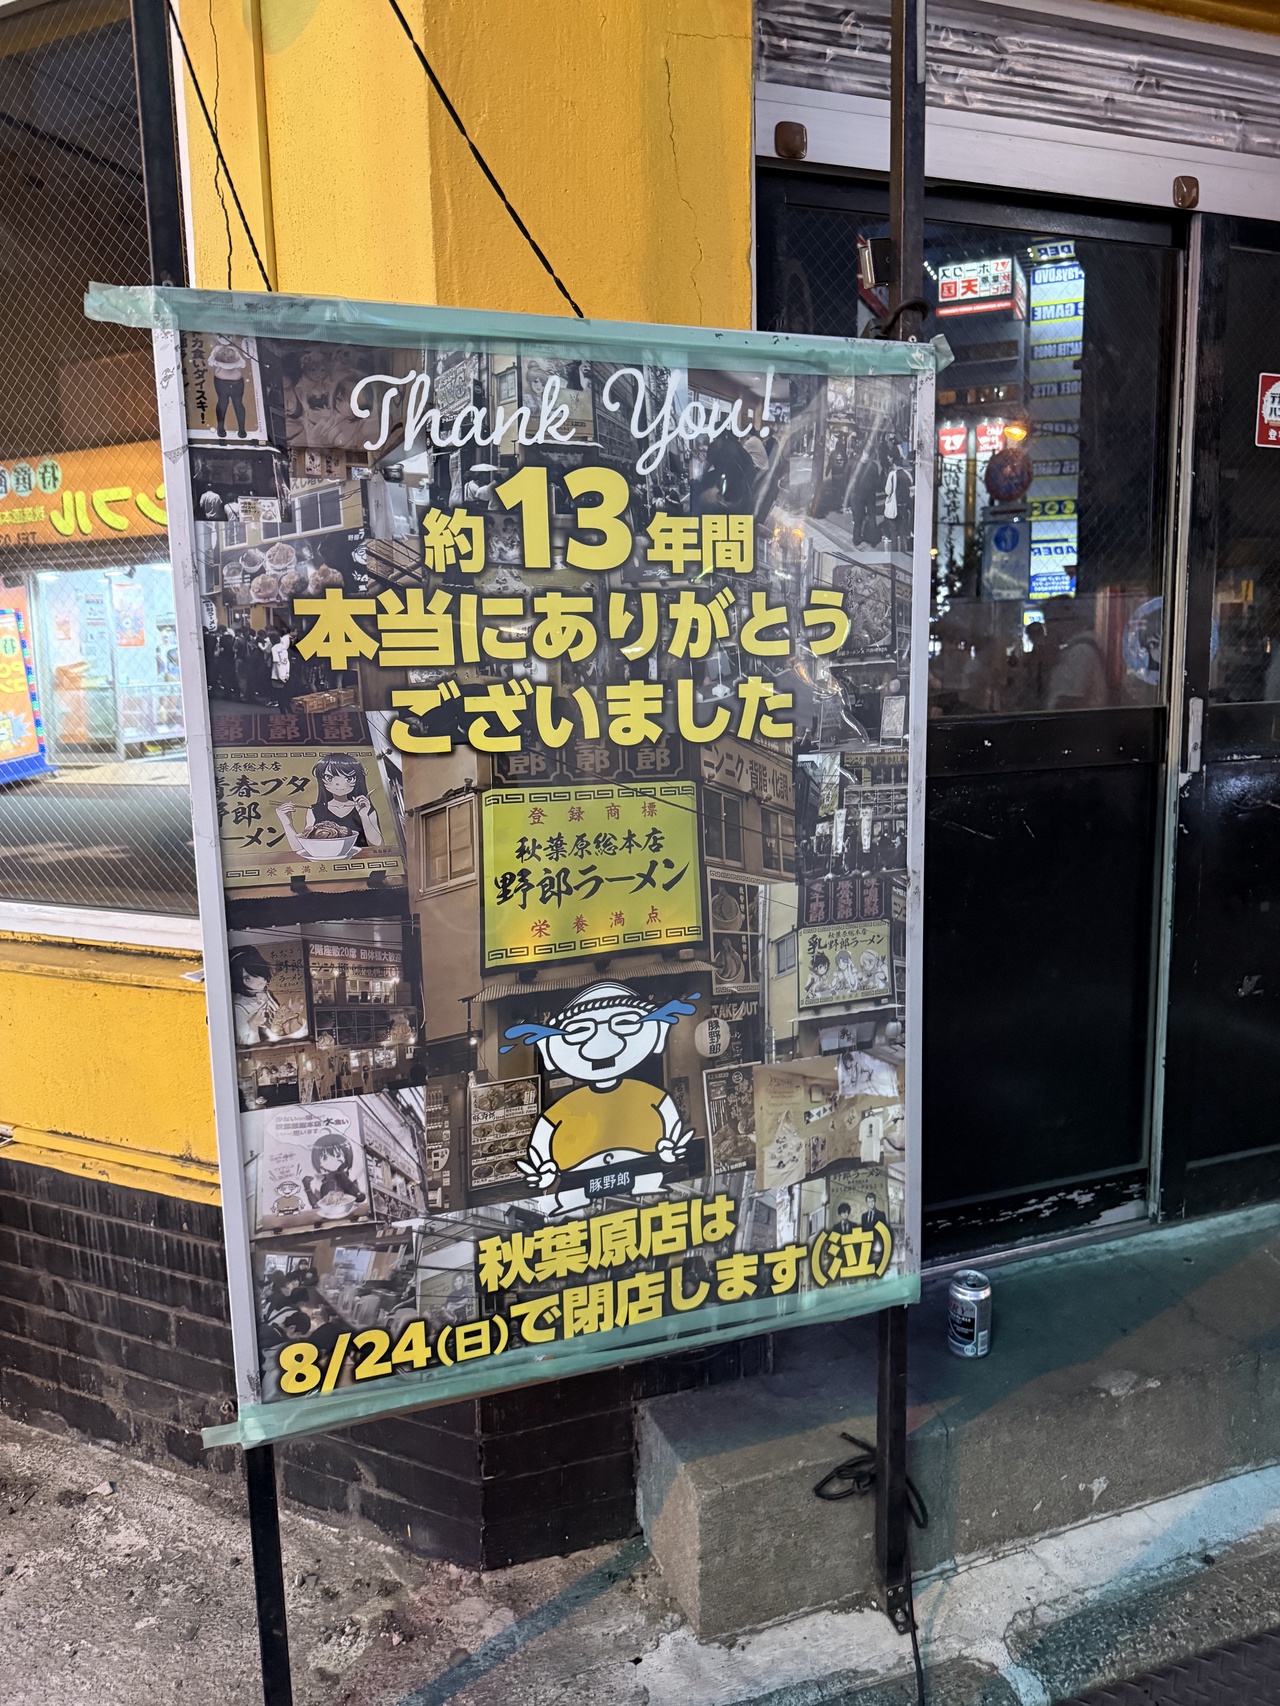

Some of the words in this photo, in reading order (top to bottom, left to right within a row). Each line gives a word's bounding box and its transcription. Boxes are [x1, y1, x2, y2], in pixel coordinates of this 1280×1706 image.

[350, 369, 576, 452] Thank
[602, 363, 776, 475] You!
[422, 465, 755, 574] 約13年間
[293, 586, 851, 671] 本当にありがとう
[390, 676, 793, 753] ございました
[216, 761, 282, 773] 葉原総本店
[528, 801, 659, 826] 登録商標
[220, 826, 286, 849] ーメン
[515, 826, 666, 863] 秋葉原総本店
[494, 857, 691, 910] 野郎ラーメン
[530, 905, 662, 939] 栄養満点
[707, 1019, 722, 1055] 豚野郎
[589, 1172, 630, 1193] 豚野郎
[478, 1193, 736, 1293] 秋葉原店は
